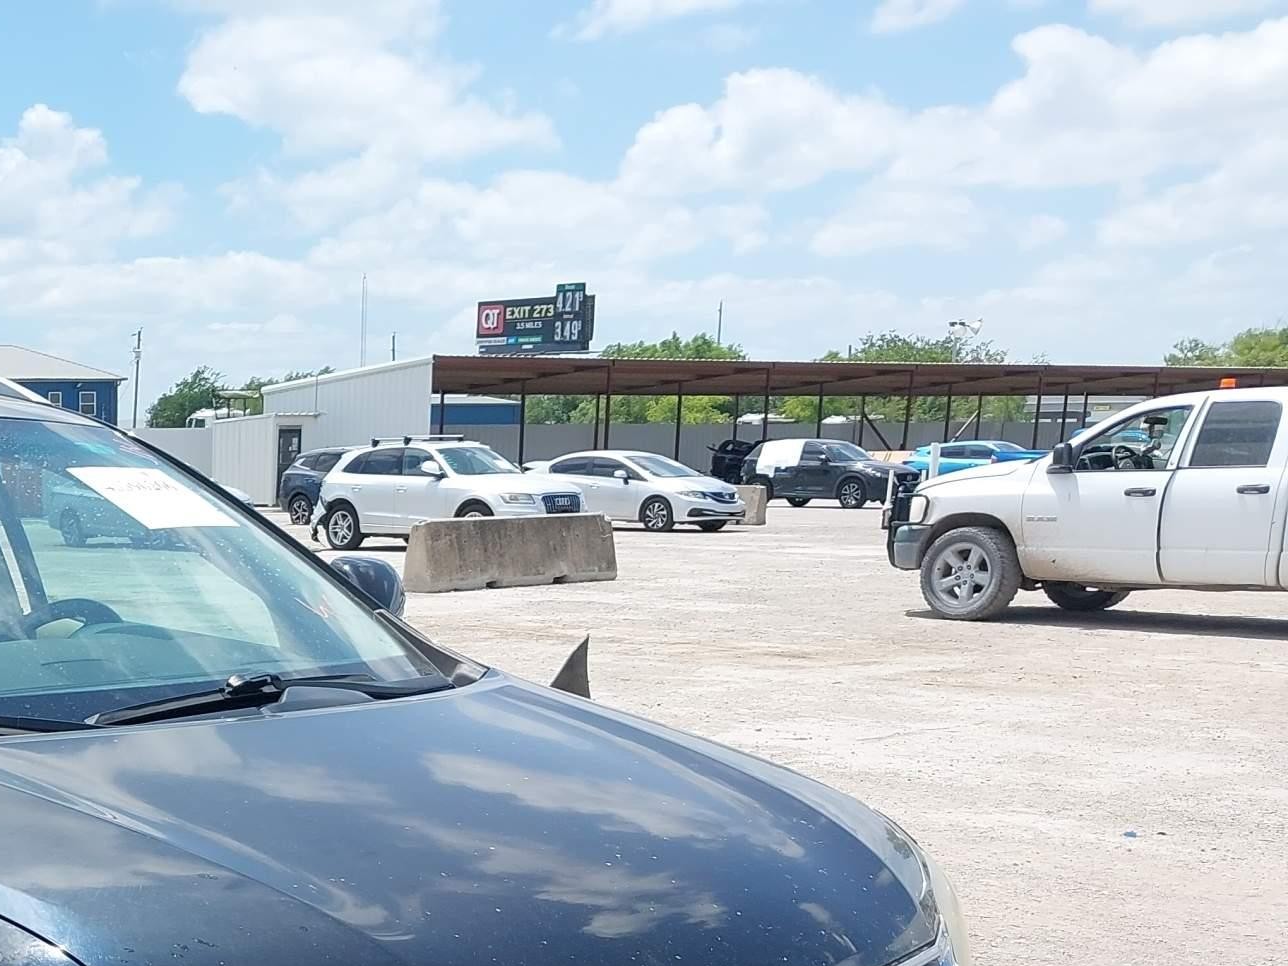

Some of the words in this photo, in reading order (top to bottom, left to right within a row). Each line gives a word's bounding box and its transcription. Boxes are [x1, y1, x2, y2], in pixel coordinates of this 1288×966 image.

[481, 309, 500, 330] QT
[505, 306, 531, 319] EXIT
[532, 304, 554, 317] 273
